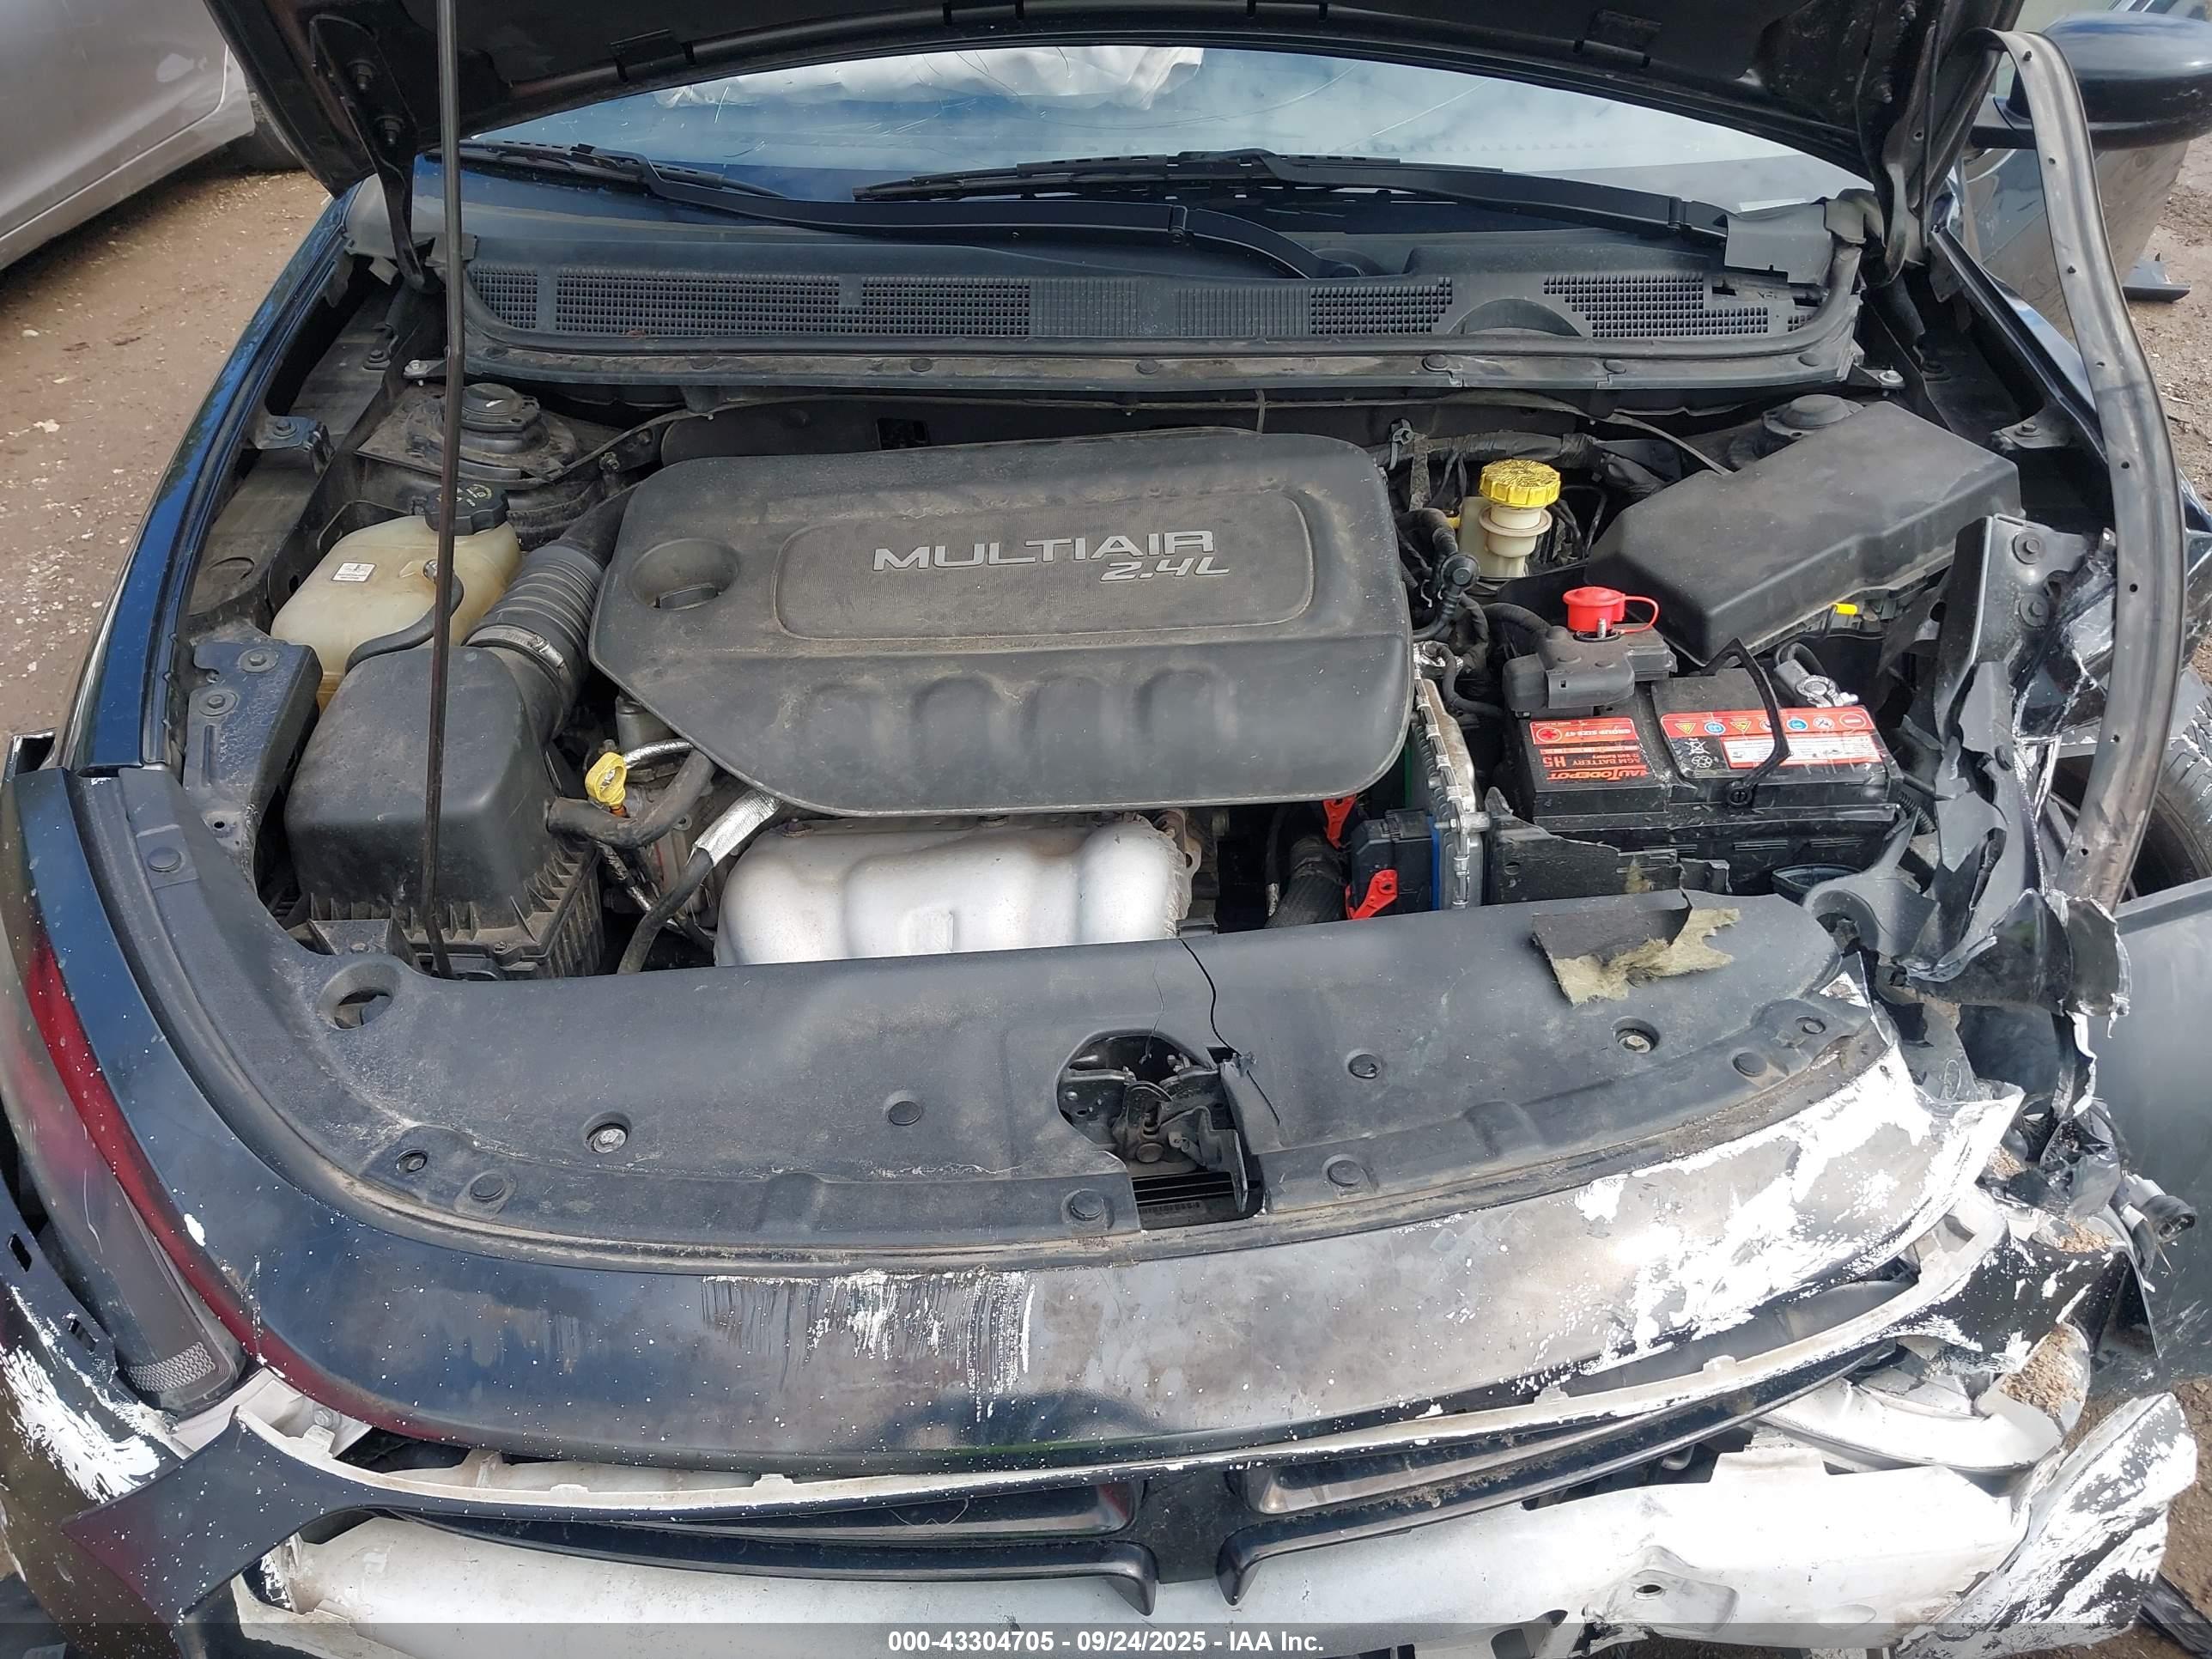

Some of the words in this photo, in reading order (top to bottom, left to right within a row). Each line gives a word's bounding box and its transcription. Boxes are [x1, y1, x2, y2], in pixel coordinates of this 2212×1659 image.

[873, 530, 1215, 570] MULTIAIR
[1100, 556, 1231, 582] 2.4L
[1542, 757, 1567, 768] H5
